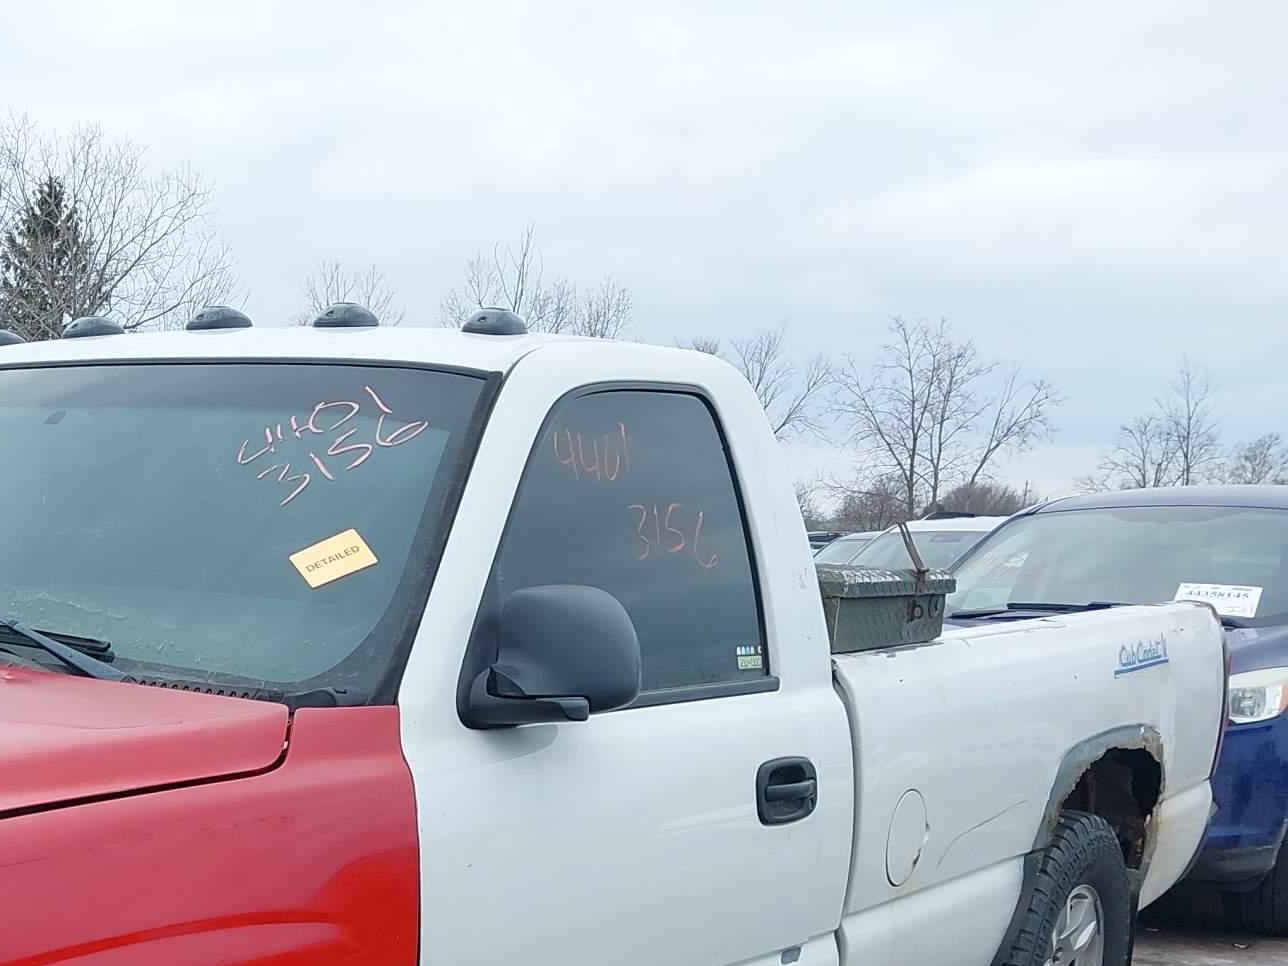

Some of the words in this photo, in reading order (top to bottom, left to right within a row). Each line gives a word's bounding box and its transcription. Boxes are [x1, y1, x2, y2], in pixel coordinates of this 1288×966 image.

[257, 414, 430, 507] 3156
[552, 421, 632, 482] 4401
[305, 544, 361, 574] DETAILED
[628, 502, 720, 569] 3156
